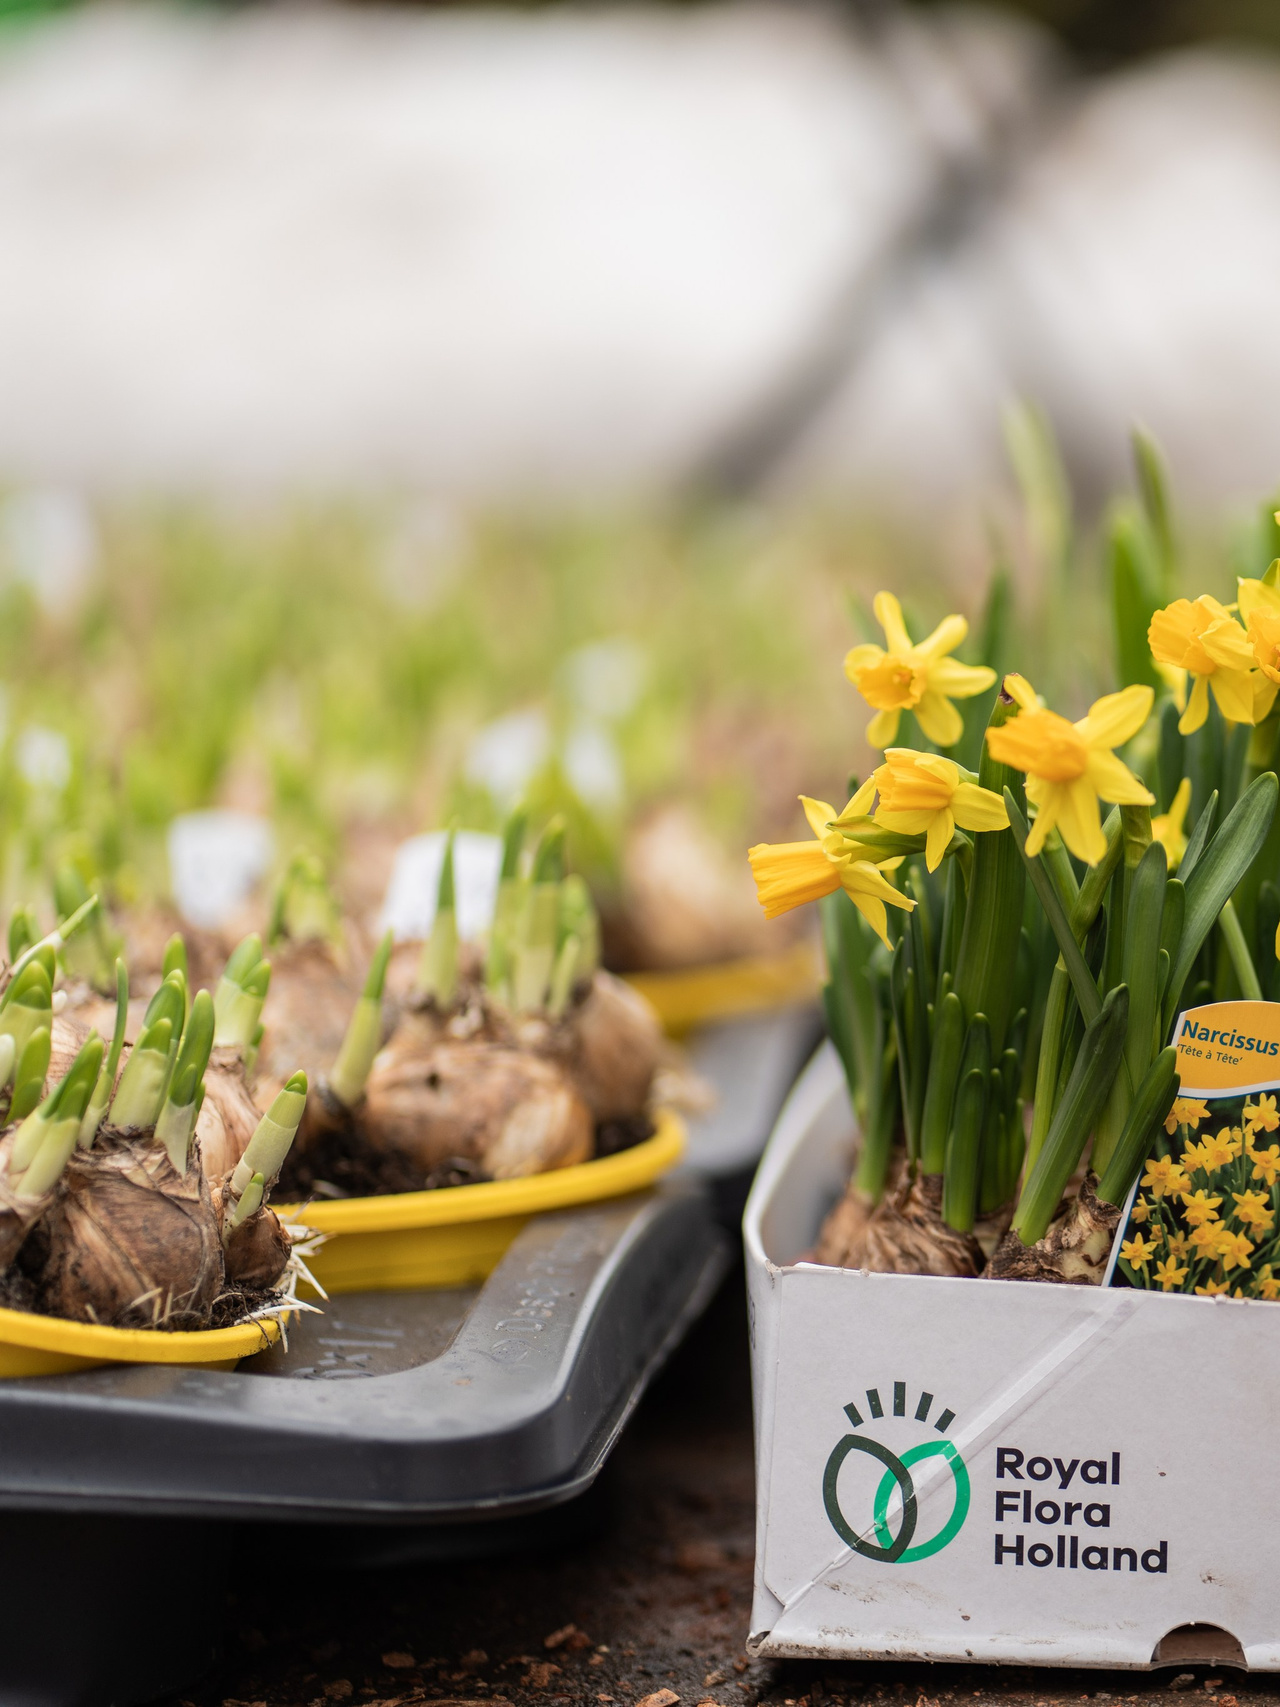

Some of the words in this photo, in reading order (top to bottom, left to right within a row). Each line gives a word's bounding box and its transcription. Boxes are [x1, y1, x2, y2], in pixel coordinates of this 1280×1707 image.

[1181, 1020, 1280, 1056] Narcissus
[1205, 1050, 1212, 1060] à
[995, 1447, 1121, 1490] Royal
[995, 1490, 1112, 1527] Flora
[993, 1533, 1169, 1574] Holland
